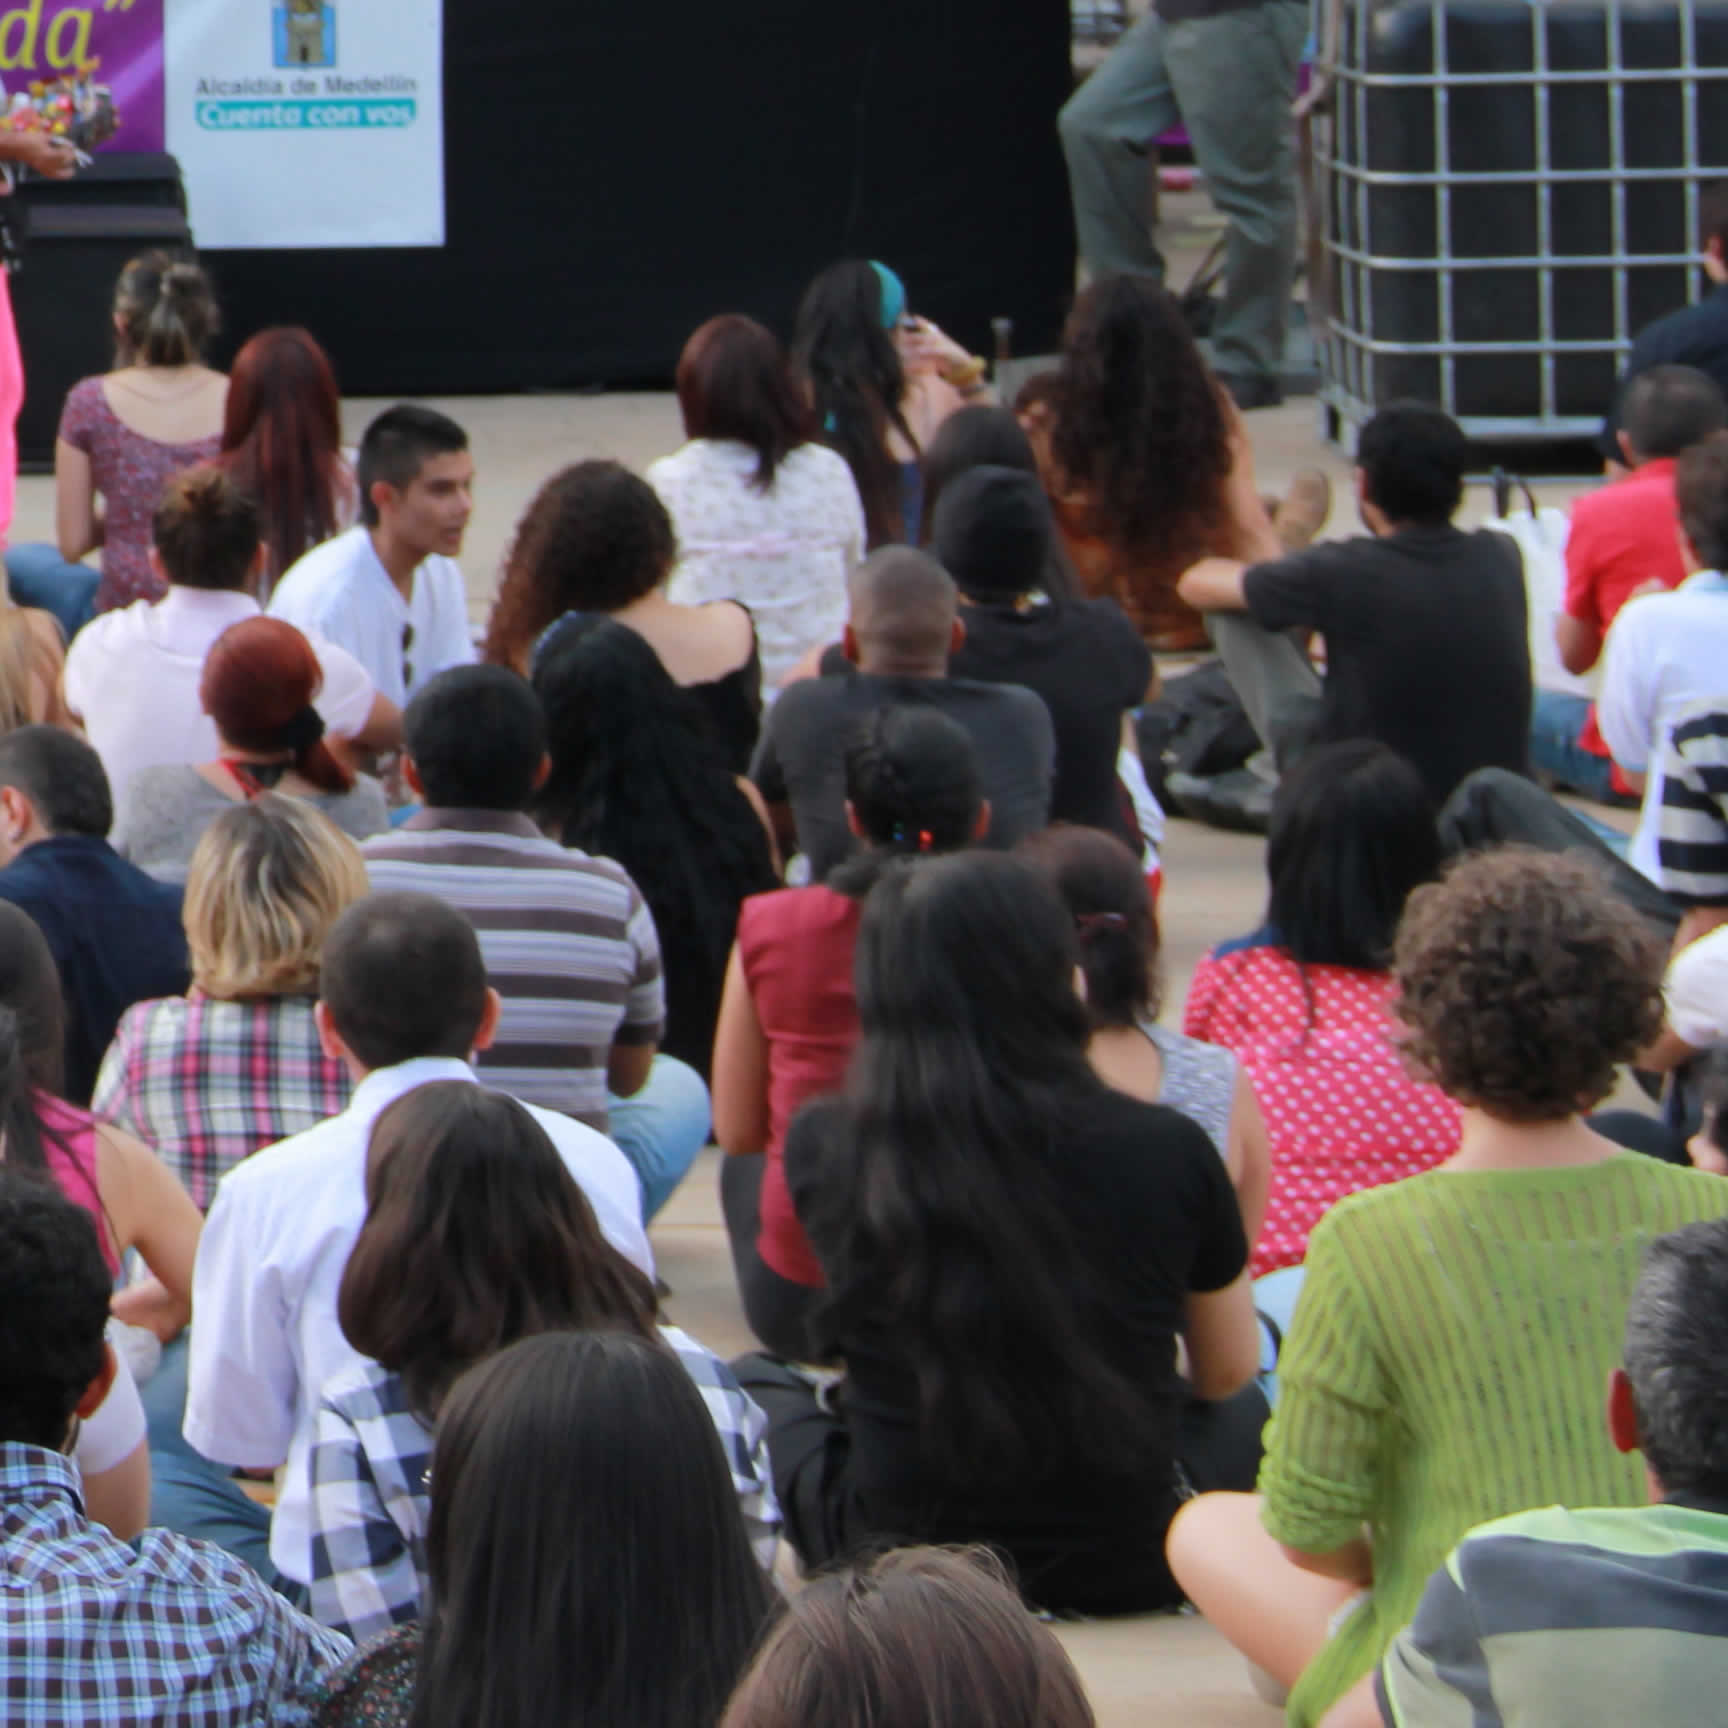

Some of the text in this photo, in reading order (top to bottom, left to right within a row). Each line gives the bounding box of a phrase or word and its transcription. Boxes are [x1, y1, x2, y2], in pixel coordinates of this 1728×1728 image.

[198, 104, 413, 128] Cuenta con vos
